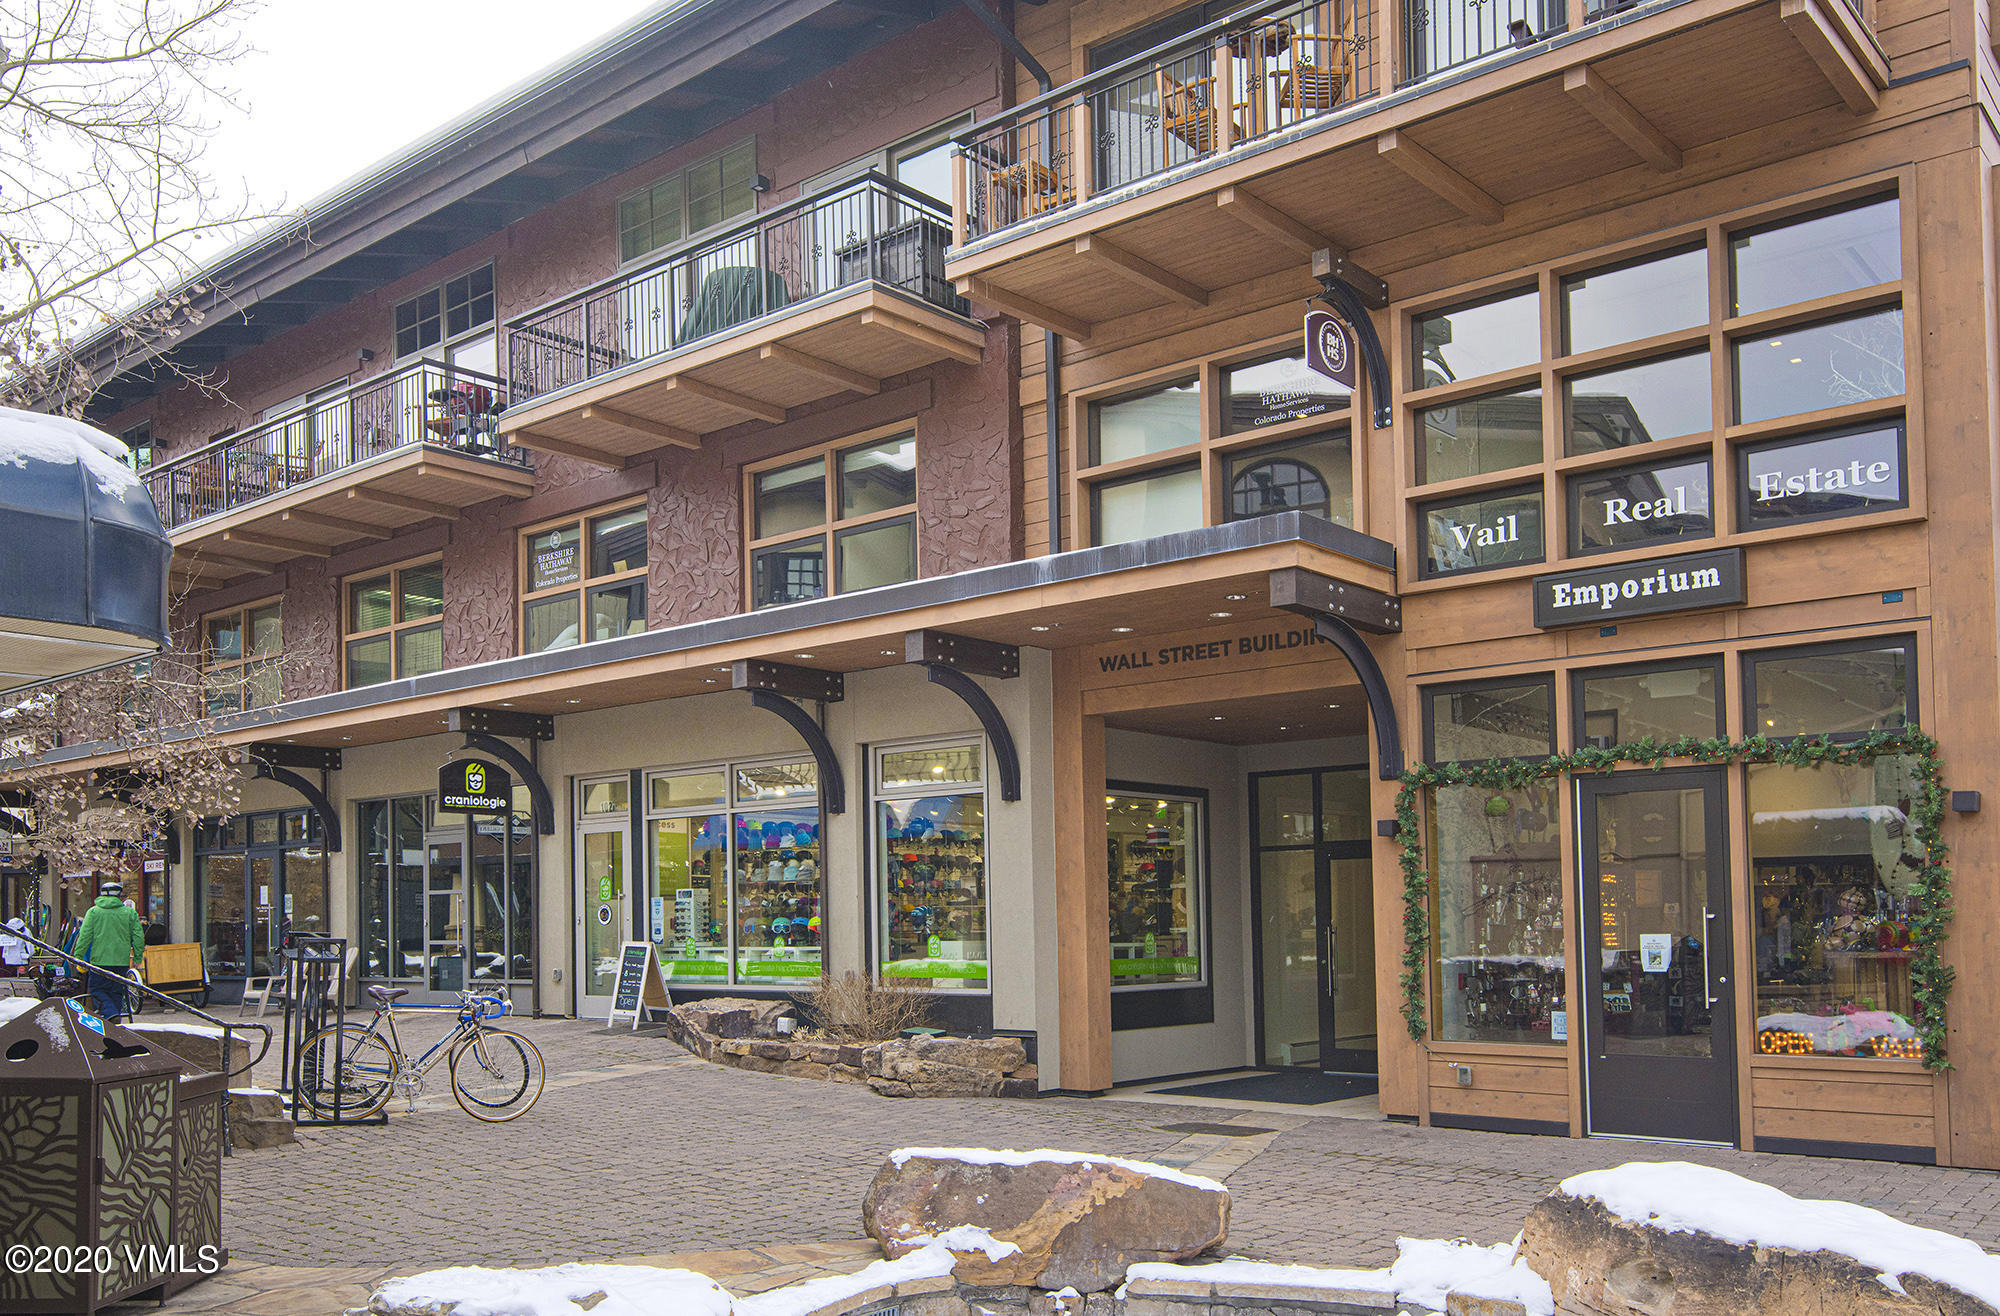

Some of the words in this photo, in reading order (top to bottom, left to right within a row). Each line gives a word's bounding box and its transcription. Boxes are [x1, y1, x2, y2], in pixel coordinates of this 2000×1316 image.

[1326, 332, 1339, 349] BH
[1327, 345, 1340, 361] HS
[1262, 389, 1315, 406] HATHAWAY
[1254, 411, 1287, 426] Colorado
[1287, 403, 1326, 418] Properties
[1449, 514, 1519, 550] Vail
[1602, 486, 1688, 526] Real
[1755, 459, 1891, 502] Estate
[537, 547, 575, 563] BERKSHIRE
[539, 556, 574, 570] HATHAWAY
[535, 577, 556, 588] Colorado
[555, 573, 578, 585] Properties
[1551, 566, 1721, 609] Emporium
[1098, 650, 1153, 673] WALL
[1158, 639, 1233, 665] STREET
[1239, 628, 1325, 655] BUILDIN
[444, 795, 506, 809] craniologie
[1760, 1031, 1815, 1054] OPEN
